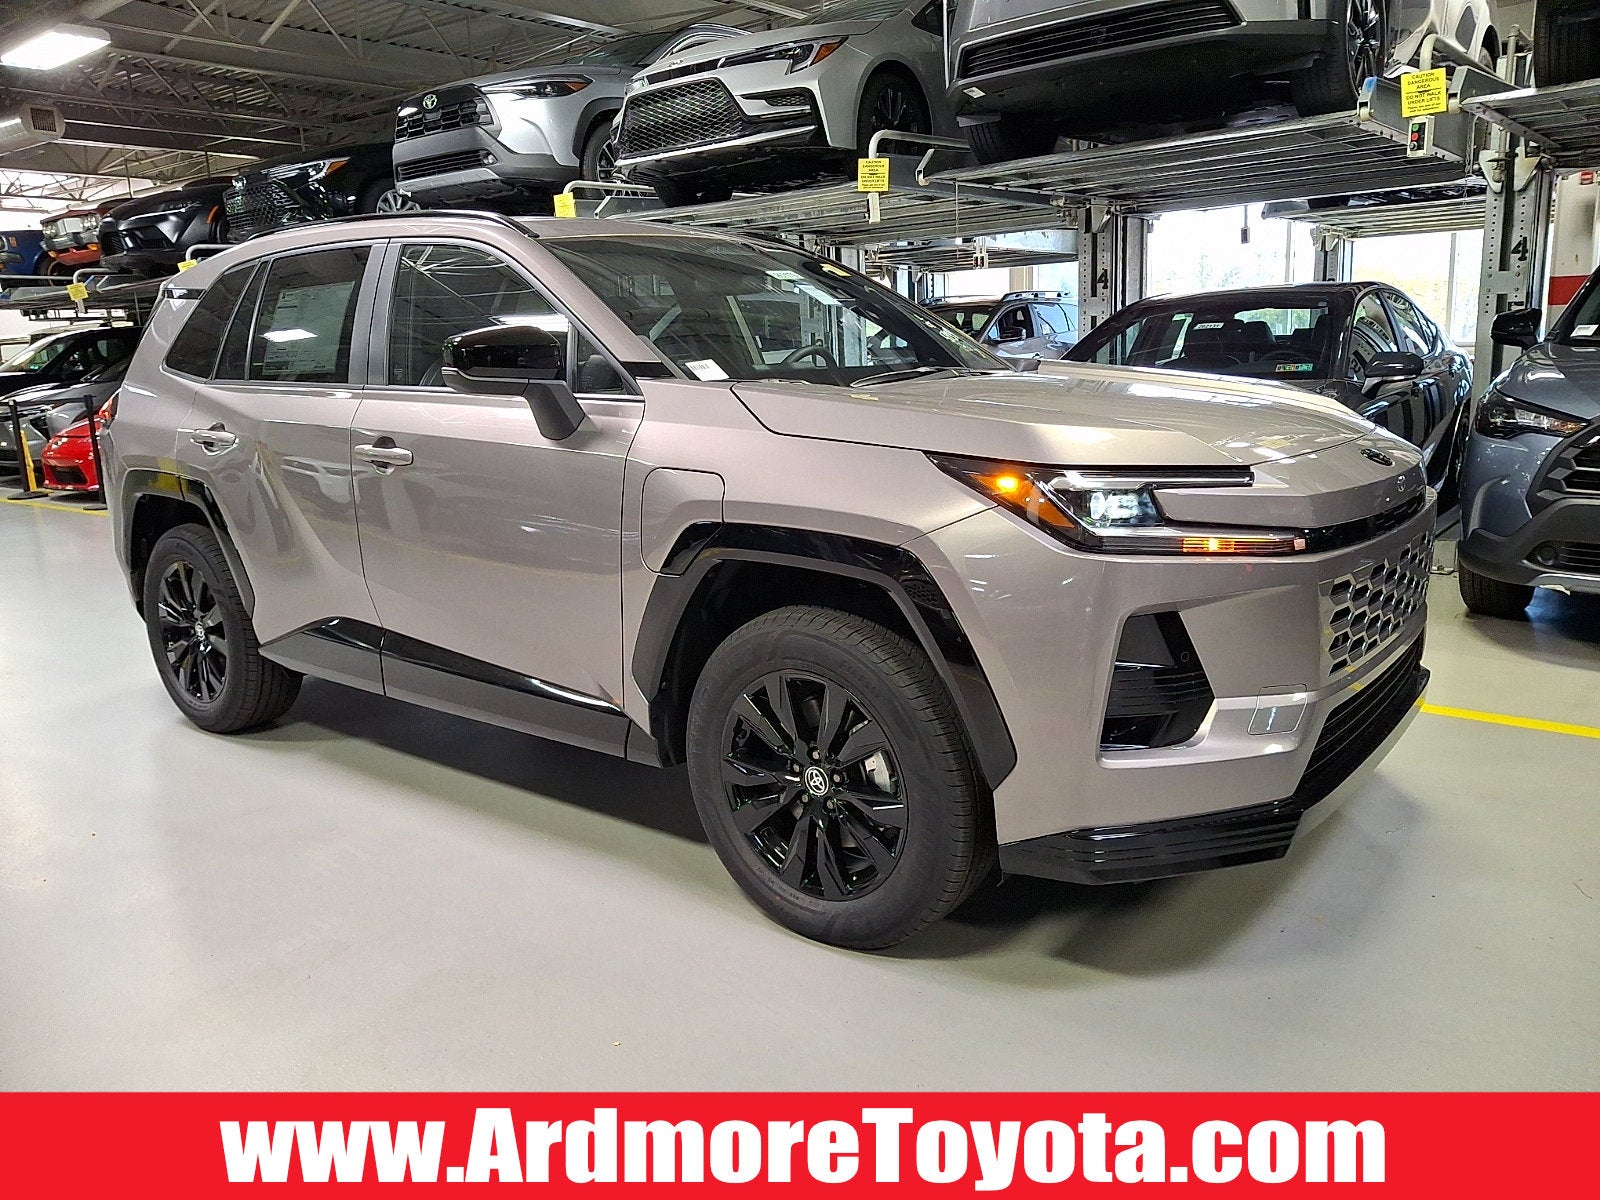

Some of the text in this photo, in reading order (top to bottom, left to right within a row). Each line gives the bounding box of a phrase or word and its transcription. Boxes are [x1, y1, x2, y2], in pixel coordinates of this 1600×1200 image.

[1408, 77, 1439, 85] DANGEROUS
[1511, 236, 1529, 262] 4
[1097, 268, 1109, 289] 4
